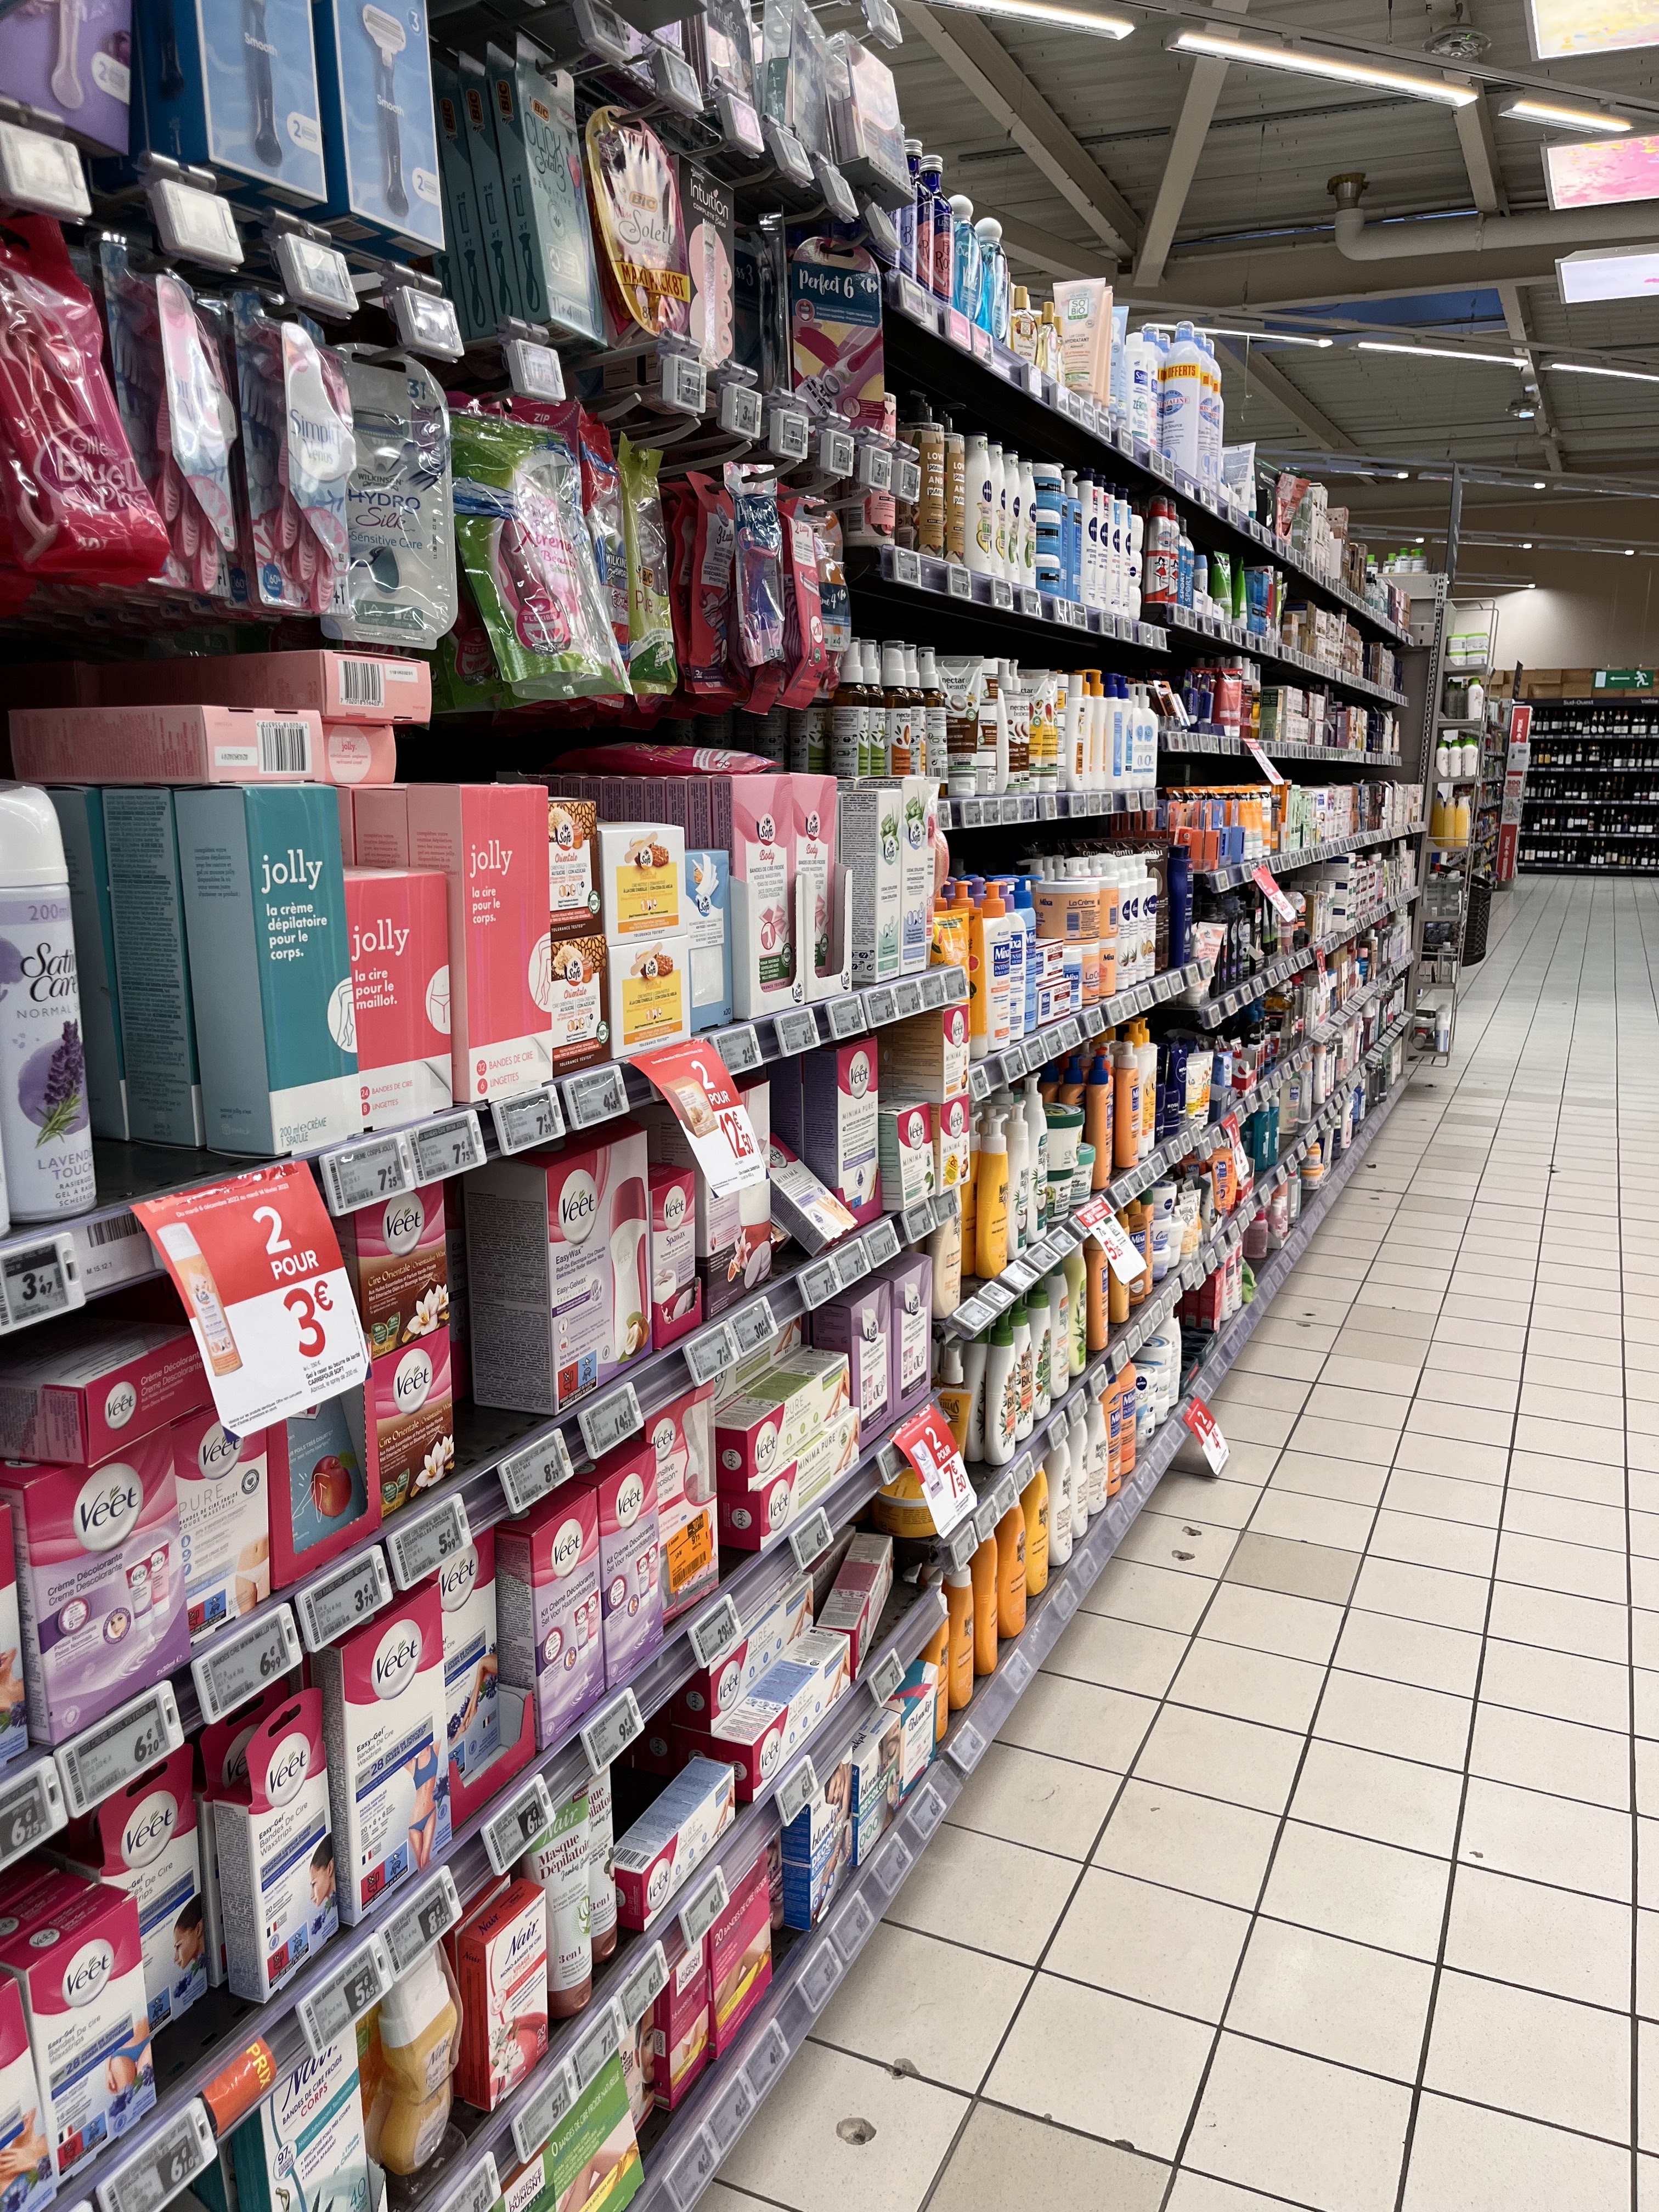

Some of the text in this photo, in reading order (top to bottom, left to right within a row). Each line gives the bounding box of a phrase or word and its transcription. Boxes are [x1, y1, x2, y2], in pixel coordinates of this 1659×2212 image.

[409, 10, 421, 32] 3
[244, 32, 278, 57] Smooth
[377, 94, 405, 116] Smooth
[533, 99, 549, 119] BIC
[631, 195, 657, 210] BIC
[690, 178, 730, 221] Intuition
[618, 210, 675, 246] Soleil
[798, 269, 854, 298] Perfect 6
[1071, 298, 1086, 307] SO
[534, 413, 551, 423] ZIP
[347, 488, 421, 511] HYDRO
[355, 507, 407, 531] Silk
[351, 530, 423, 550] Sensitive Care
[642, 569, 653, 584] BIC
[635, 590, 654, 613] Pure
[558, 831, 572, 844] Soft
[761, 828, 775, 841] Soft
[470, 839, 513, 878] jolly
[641, 854, 652, 865] Soft
[759, 849, 775, 865] Body
[806, 845, 819, 859] Body
[261, 849, 323, 894] jolly
[472, 885, 496, 898] la cire
[1039, 898, 1053, 906] Mixa
[267, 901, 313, 916] la crème
[472, 898, 500, 913] pour le
[268, 913, 328, 931] dépilatoire
[472, 912, 496, 926] corps.
[269, 931, 309, 949] pour le
[352, 918, 409, 961] jolly
[270, 947, 304, 962] corps.
[355, 968, 388, 982] la cire
[356, 980, 394, 998] pour le
[17, 1005, 71, 1019] NORMAL
[356, 996, 398, 1011] maillot.
[489, 1050, 534, 1070] BANDES CIRE
[490, 1071, 520, 1087] LINGETTES
[690, 1060, 715, 1091] 2
[372, 1098, 399, 1111] LINGETTES
[707, 1090, 731, 1106] POUR
[842, 1102, 874, 1121] MINIMA PURE
[279, 1116, 327, 1137] 200 CRÈME
[285, 1131, 309, 1147] SPATULE
[902, 1153, 922, 1167] MINIMA
[561, 1189, 597, 1223] Veet
[252, 1205, 292, 1256] 2
[665, 1232, 686, 1248] Spawax
[1131, 1234, 1146, 1244] Mixa
[270, 1250, 319, 1281] POUR
[382, 1263, 411, 1281] Orientale
[140, 1369, 162, 1386] Crème
[308, 1370, 334, 1386] CARREFOUR
[1021, 1371, 1032, 1388] BIO
[140, 1380, 161, 1397] Creme
[785, 1394, 805, 1416] PURE
[1197, 1410, 1207, 1425] 2
[926, 1427, 942, 1447] 2
[797, 1447, 821, 1470] MINIMA
[937, 1446, 952, 1462] POUR
[79, 1485, 139, 1534] Veet
[178, 1482, 224, 1517] PURE
[617, 1487, 643, 1515] Veet
[552, 1534, 582, 1564] Veet
[47, 1551, 124, 1597] Crème Décolorante
[48, 1562, 123, 1607] Creme Descolorante
[541, 1570, 596, 1619] Kit Crème Décolorante
[541, 1578, 597, 1628] Set Voor Haarontkleuring
[376, 1639, 419, 1686] Veet
[357, 1729, 394, 1761] Bandes Cire
[357, 1746, 382, 1768] Waxstrips
[370, 1758, 385, 1777] 28
[269, 1750, 308, 1794] Veet
[859, 1771, 889, 1814] DECOLOR
[125, 1809, 174, 1854] Veet
[259, 1801, 308, 1849] Bandes De Cire
[259, 1826, 292, 1857] Waxstrips
[537, 1834, 580, 1867] Masque
[811, 1816, 844, 1869] DECOLOR
[477, 1912, 501, 1934] Nair
[505, 1918, 539, 1965] Nair
[714, 1928, 723, 1947] 20
[565, 1949, 577, 1961] en
[65, 1953, 111, 1997] Veet
[246, 2042, 272, 2091] PRIX
[282, 2053, 343, 2126] BANDES DE CIRE FROIDE
[300, 2081, 329, 2118] CORPS
[508, 2166, 543, 2207] LAURENCE
[510, 2174, 543, 2212] DUMONT
